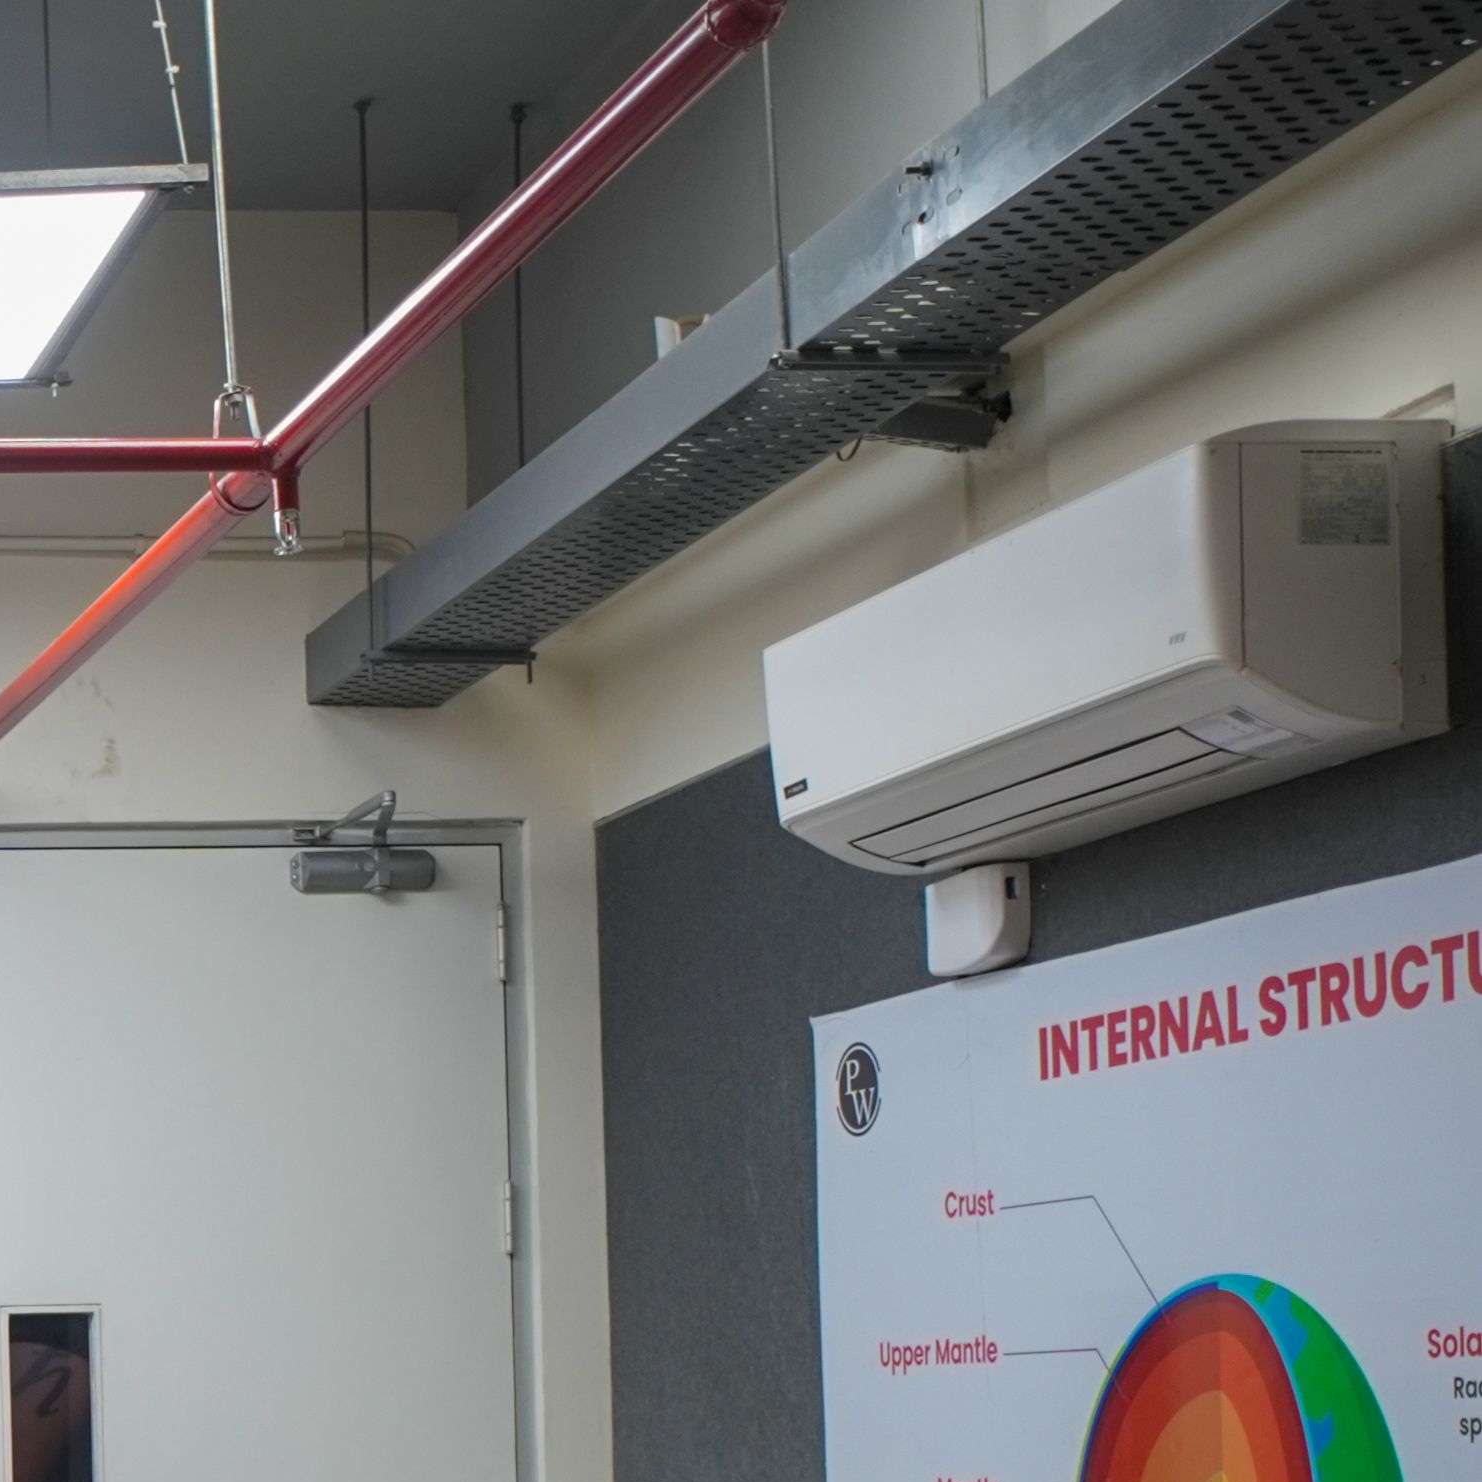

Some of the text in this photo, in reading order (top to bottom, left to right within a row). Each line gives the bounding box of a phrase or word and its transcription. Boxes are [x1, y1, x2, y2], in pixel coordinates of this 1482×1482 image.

[1039, 985, 1248, 1080] INTERNAL
[945, 1190, 994, 1218] Crust
[880, 1336, 997, 1375] Upper Mantle
